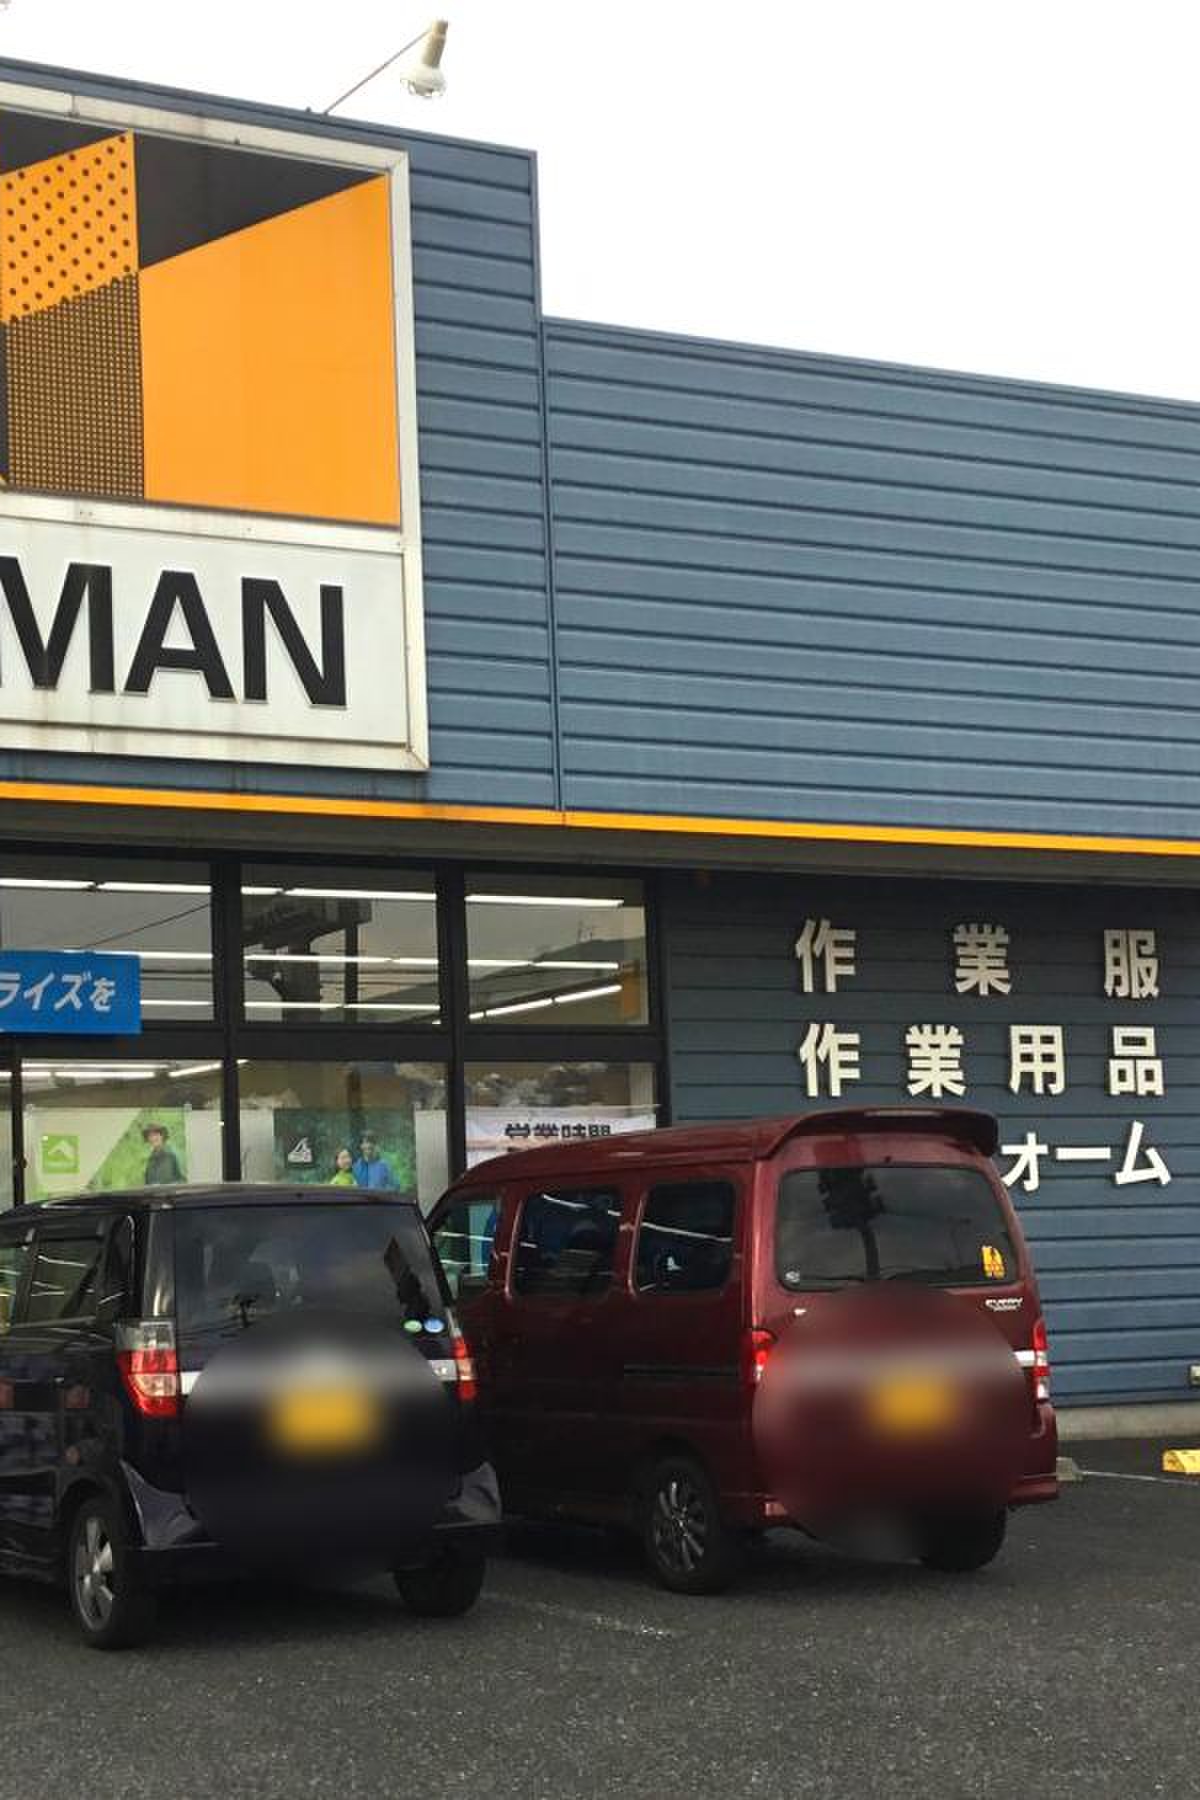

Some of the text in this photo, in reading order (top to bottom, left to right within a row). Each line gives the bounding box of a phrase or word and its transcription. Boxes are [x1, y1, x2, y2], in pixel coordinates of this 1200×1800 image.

[795, 917, 1160, 998] 作業服
[799, 1023, 1164, 1098] 作業用品
